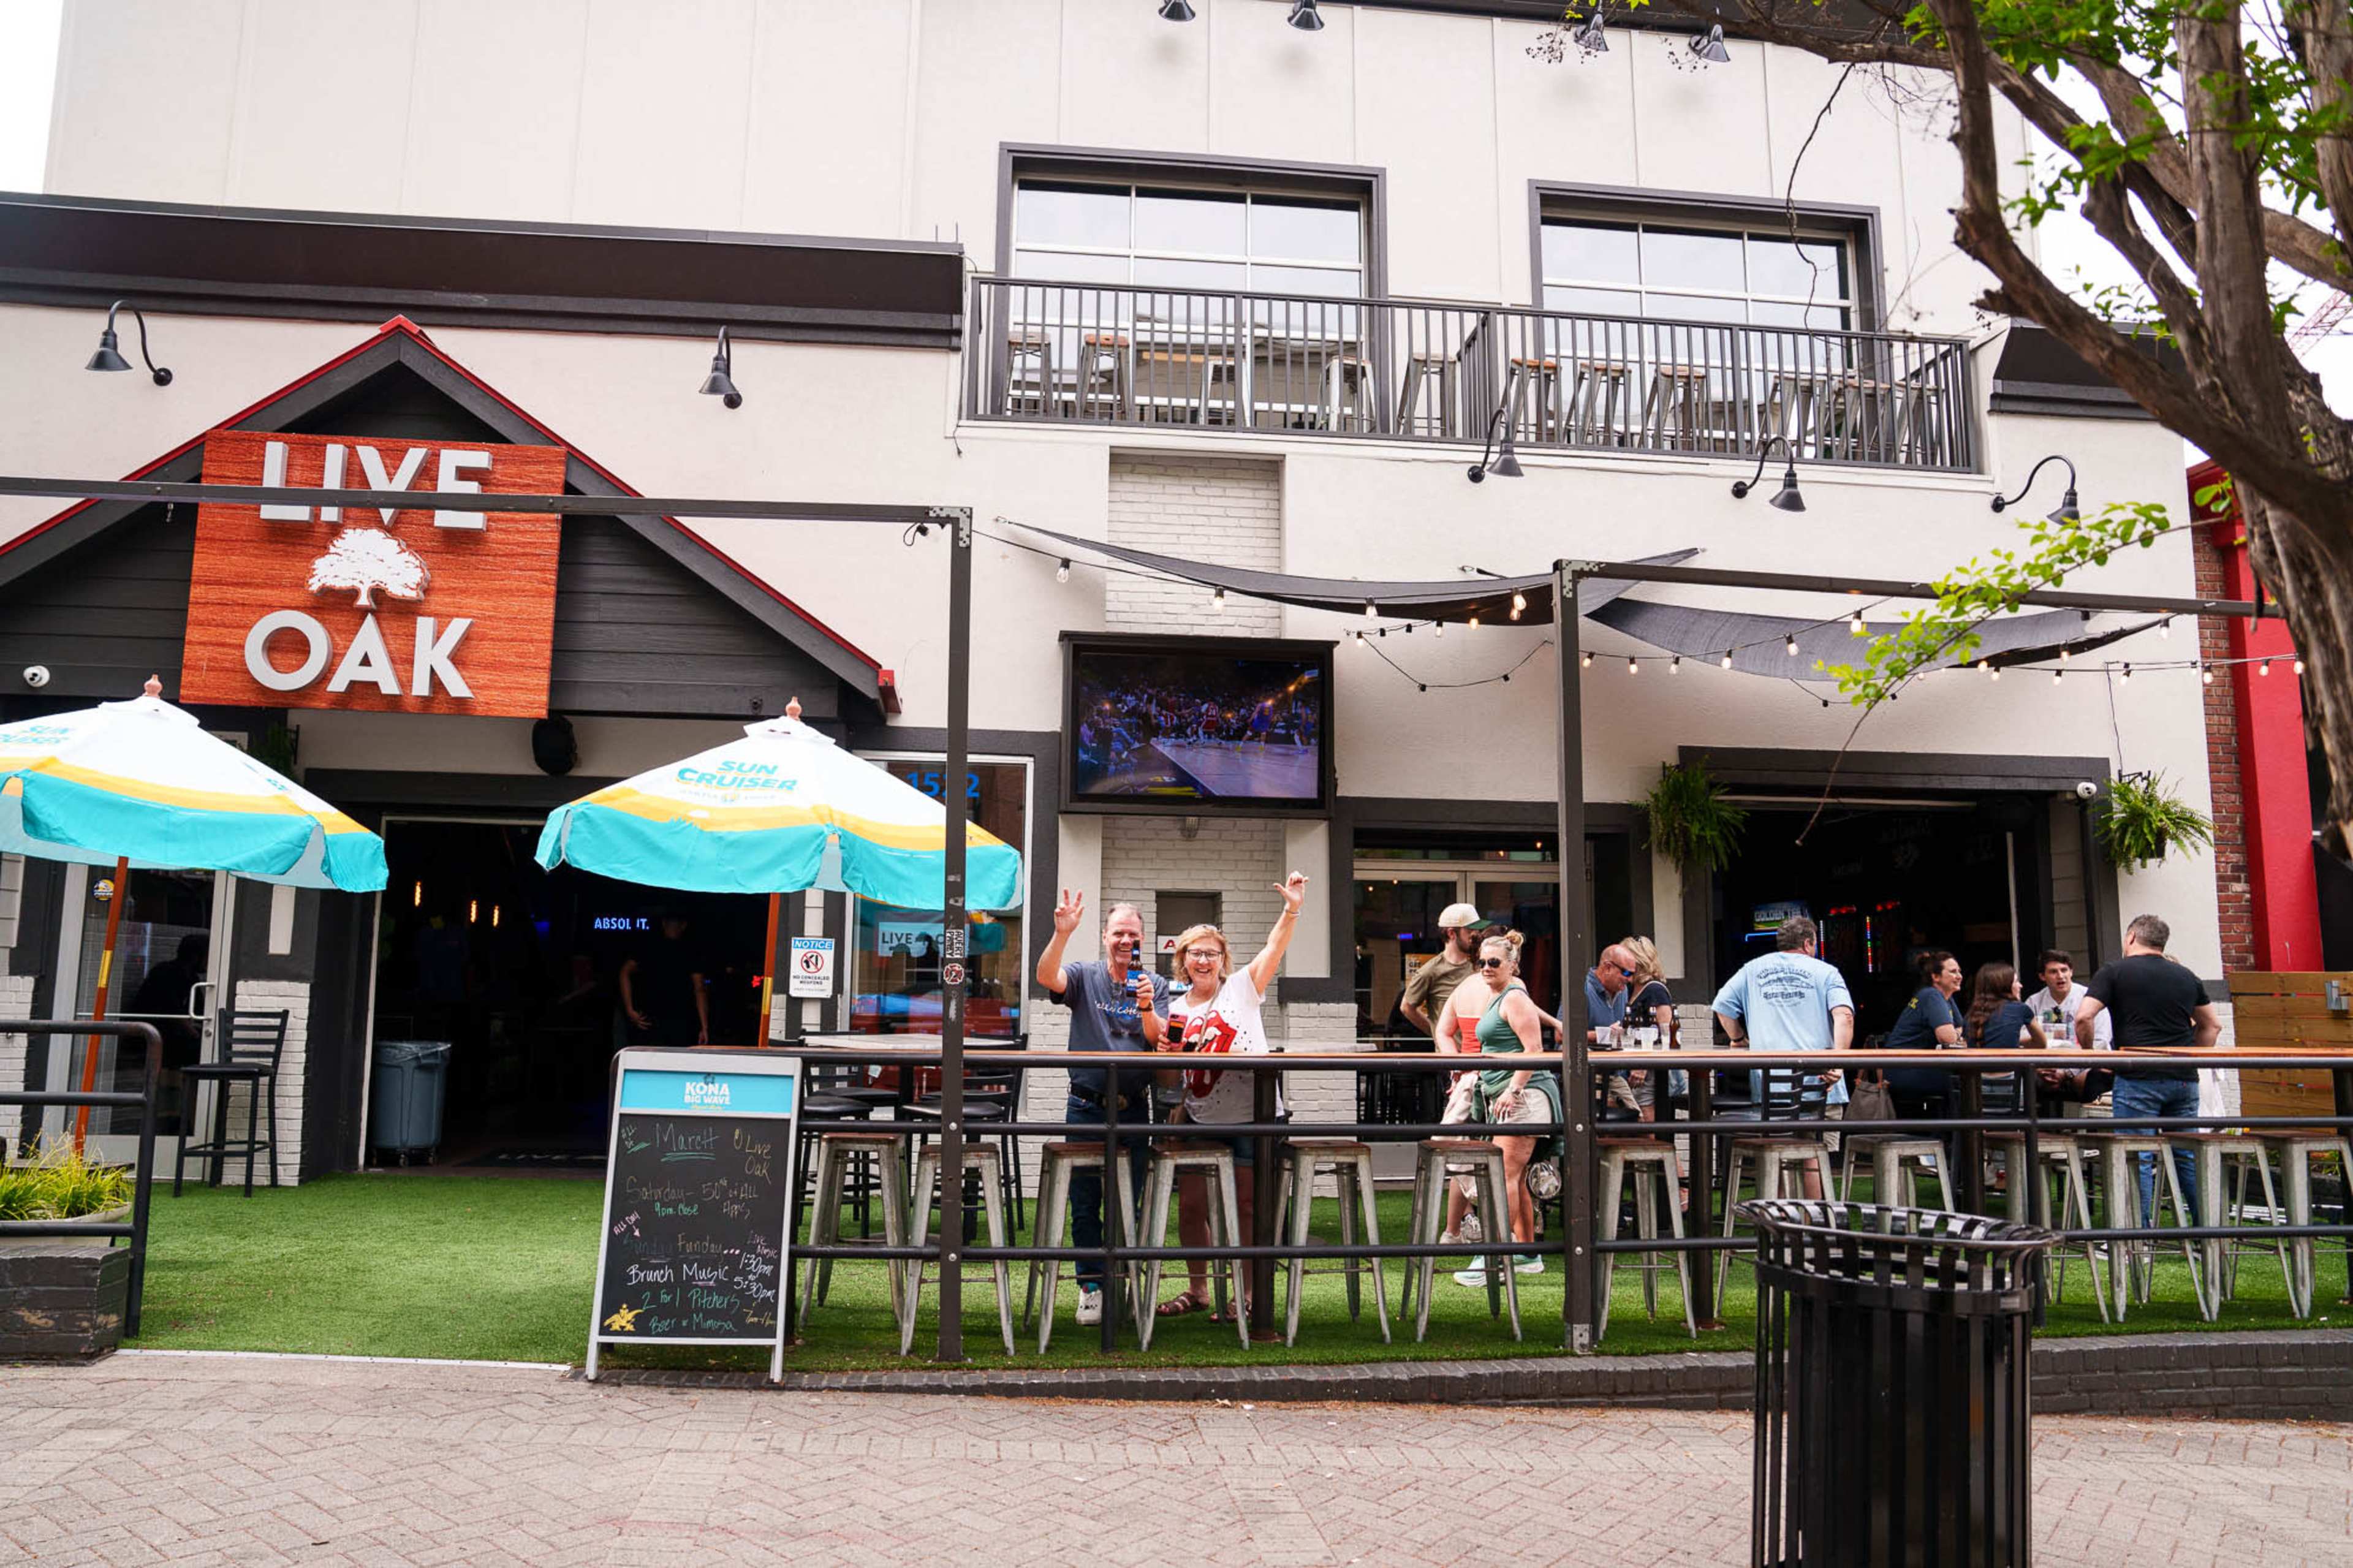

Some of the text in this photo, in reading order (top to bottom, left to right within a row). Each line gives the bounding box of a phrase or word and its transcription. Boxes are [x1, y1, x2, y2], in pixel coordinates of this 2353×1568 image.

[260, 441, 493, 531] LIVE
[244, 610, 476, 700] OAK
[676, 767, 798, 791] CRUISER
[716, 760, 778, 776] SUN
[906, 771, 980, 798] 152
[794, 940, 833, 950] NOTICE
[882, 932, 913, 944] LIVE
[684, 1095, 732, 1105] BIG WAVE
[685, 1082, 730, 1096] KONA
[745, 1156, 771, 1184] Oak
[626, 1262, 729, 1286] Brunch Music
